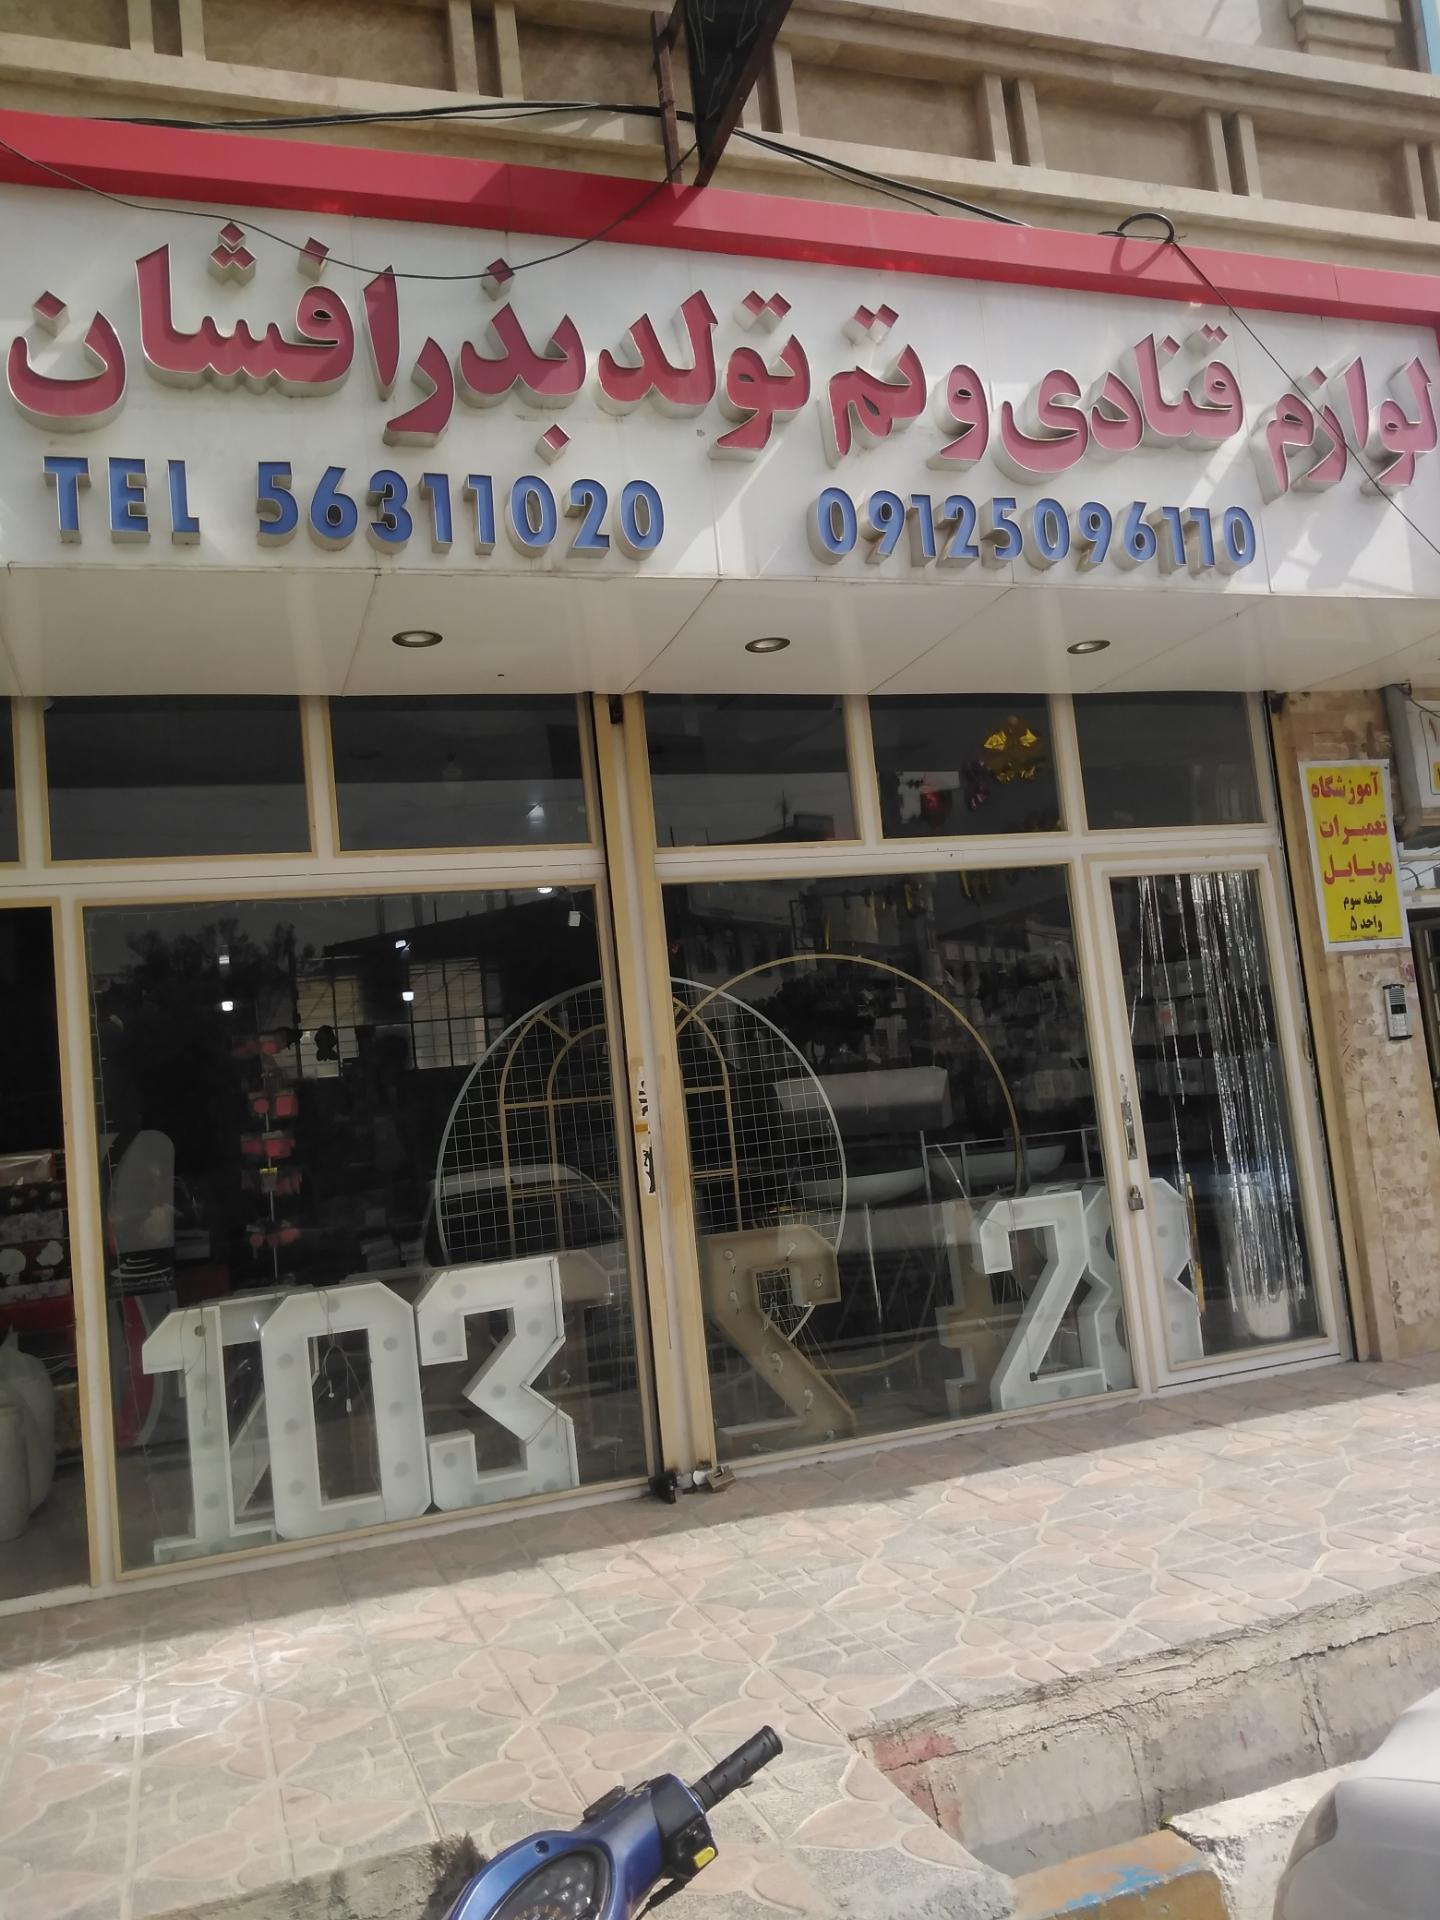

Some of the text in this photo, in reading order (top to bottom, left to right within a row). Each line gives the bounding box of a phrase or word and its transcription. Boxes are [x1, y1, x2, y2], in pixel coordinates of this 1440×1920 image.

[597, 289, 811, 460] تولد
[825, 303, 927, 468] تم
[999, 322, 1245, 484] قنادی
[1253, 354, 1438, 502] لوازم
[43, 455, 665, 560] TEL 56311020
[808, 486, 1256, 575] 09125096110
[1311, 771, 1379, 805] آموزشگاه
[1319, 814, 1388, 845] تعمیرات
[1323, 853, 1393, 885] موبایل
[1343, 890, 1383, 911] طبقه سوم
[1350, 915, 1383, 932] واحد ۵
